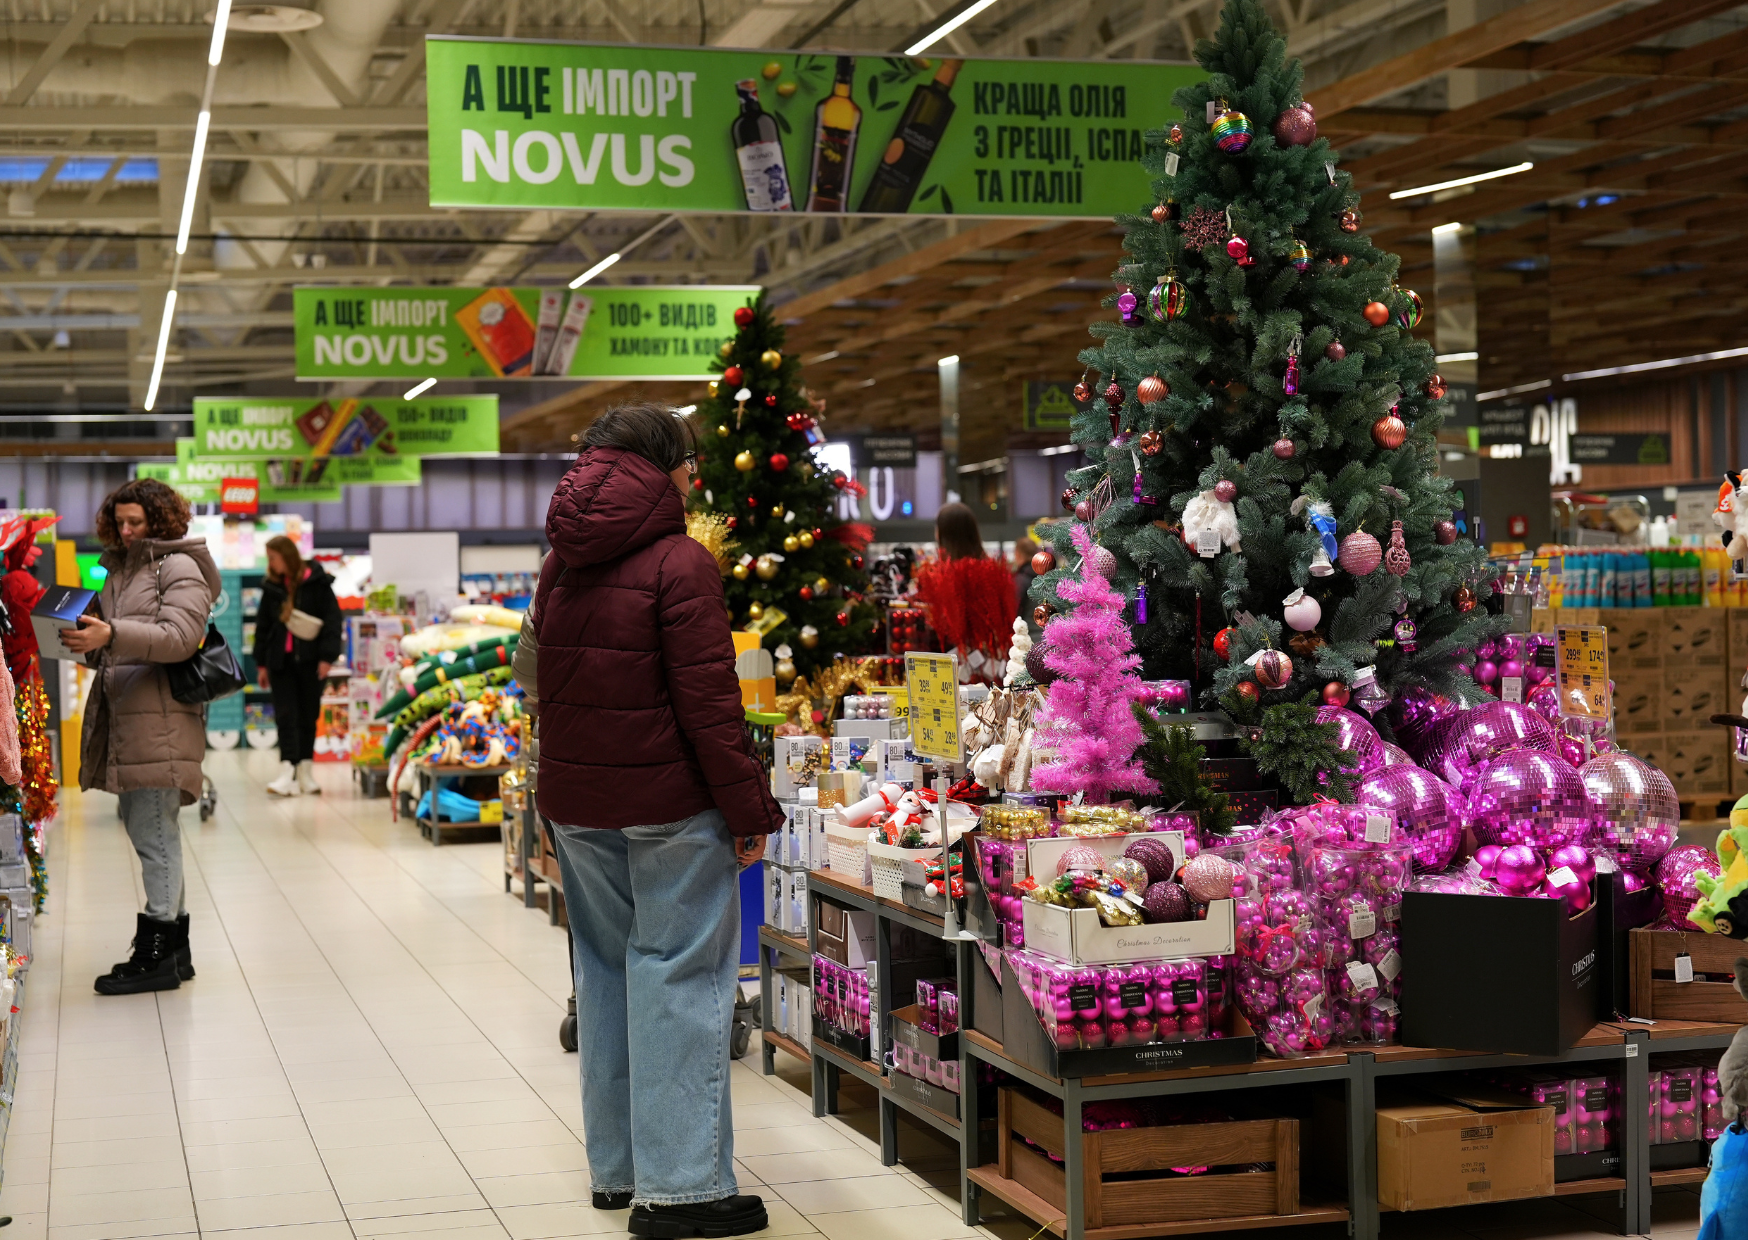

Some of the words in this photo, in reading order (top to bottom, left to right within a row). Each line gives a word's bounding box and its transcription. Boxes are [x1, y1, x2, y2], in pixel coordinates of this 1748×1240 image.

[462, 65, 485, 111] А
[497, 66, 551, 120] ЩЕ
[562, 67, 697, 118] ІМПОРТ
[974, 81, 1062, 120] КРАЩА
[1069, 84, 1126, 119] ОЛІЯ
[461, 129, 695, 188] NOVUS
[975, 169, 1004, 203] ТА
[1012, 164, 1083, 204] ІТАЛІЇ
[315, 300, 328, 326] А
[335, 300, 365, 330] ЩЕ
[371, 300, 449, 327] ІМПОРТ
[609, 303, 652, 327] 100+
[660, 304, 717, 330] ВИДІВ
[314, 335, 448, 366] NOVUS
[207, 428, 294, 451] NOVUS
[186, 462, 256, 481] NOVUS
[224, 487, 256, 503] LEGO
[1117, 938, 1151, 949] Christmas
[1153, 936, 1191, 946] Decoration
[1136, 1049, 1183, 1059] CHRISTMAS
